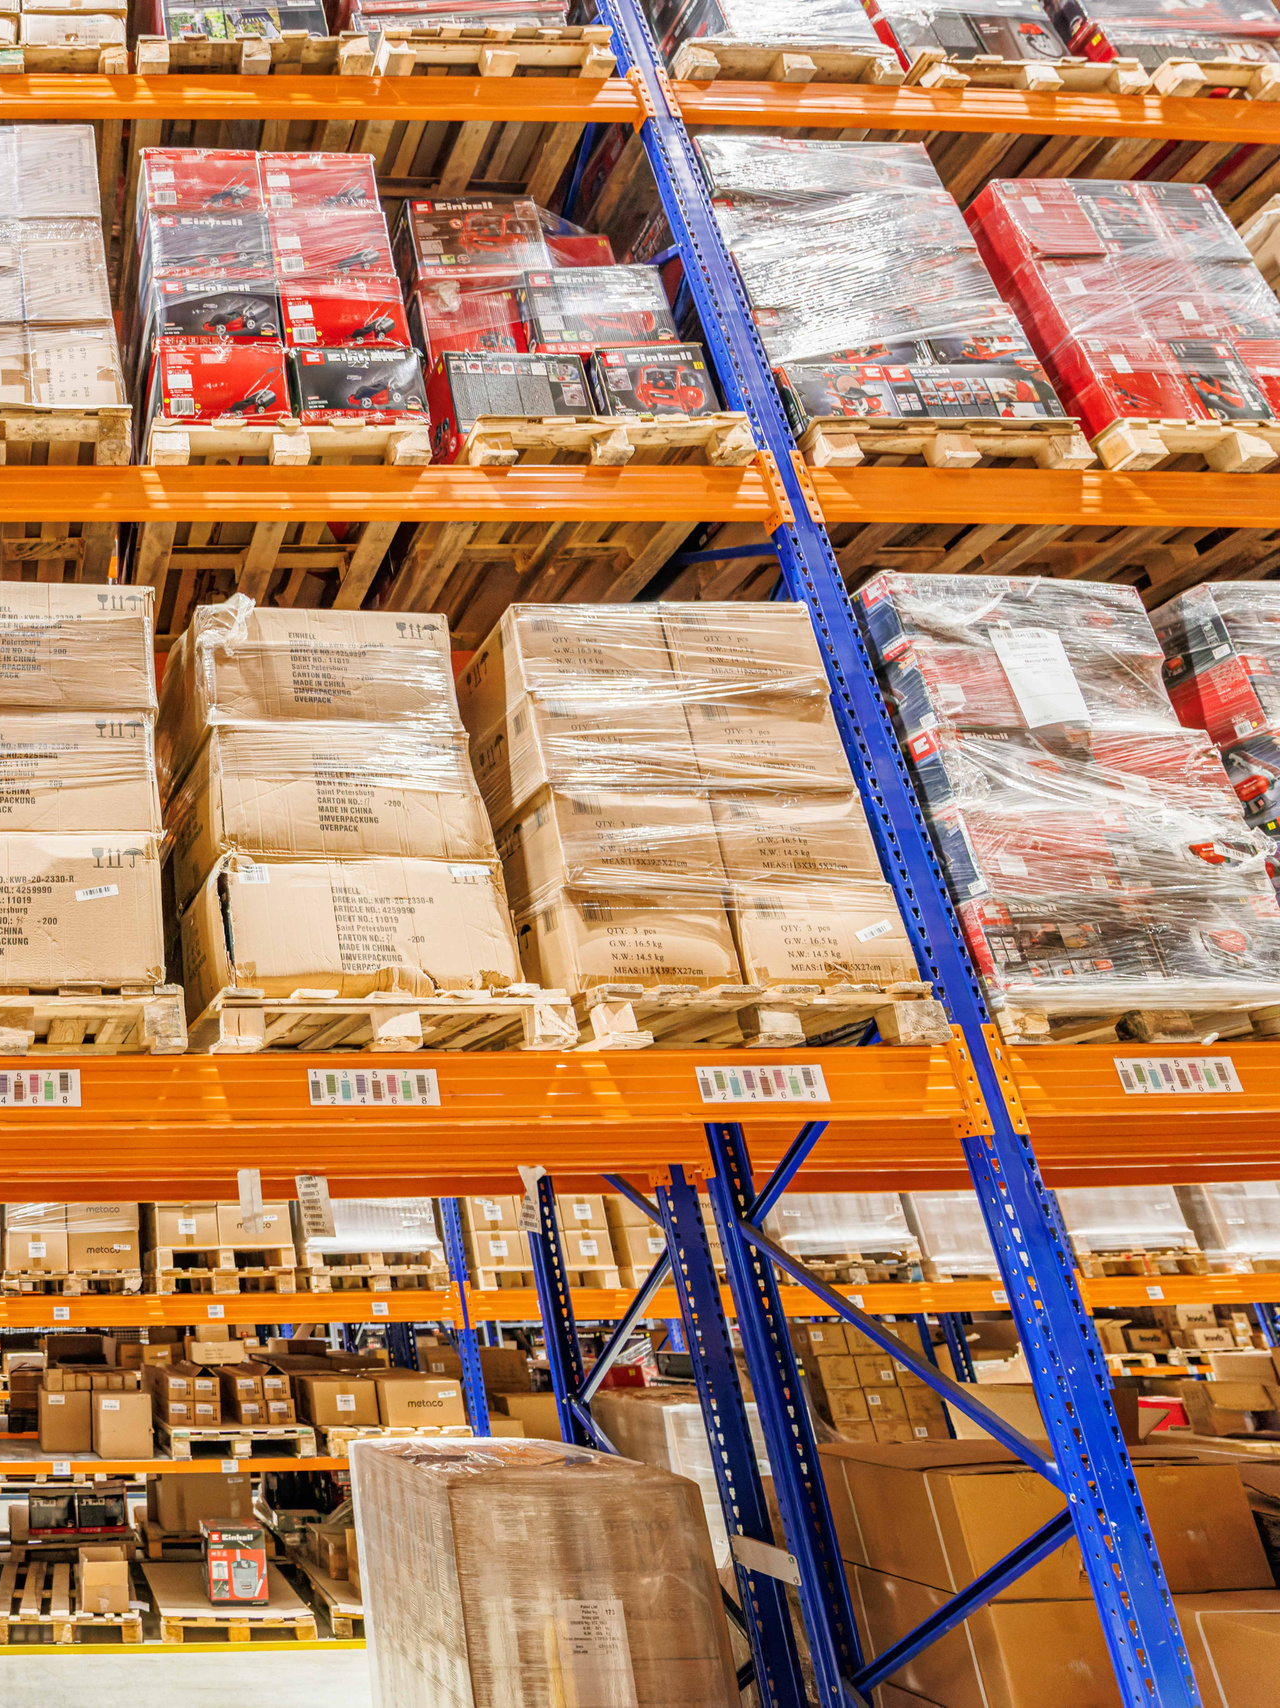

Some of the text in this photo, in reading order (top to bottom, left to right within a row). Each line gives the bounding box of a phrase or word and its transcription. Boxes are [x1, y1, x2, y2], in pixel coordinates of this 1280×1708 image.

[435, 201, 493, 211] Einhell
[181, 217, 243, 226] Einhell
[186, 282, 250, 292] Einhell
[327, 351, 406, 362] Einhell
[627, 351, 693, 363] Einhell
[914, 367, 951, 375] Einhell
[964, 731, 1008, 740] Einhell
[337, 789, 375, 797] Petersburg
[317, 797, 346, 805] CARTON
[319, 815, 379, 823] UMVERPACKUNG
[320, 824, 358, 832] OVERPACK
[798, 837, 807, 845] kg
[0, 886, 14, 894] NO.:
[16, 886, 52, 894] 4259990
[357, 925, 397, 933] Petersburg
[607, 927, 628, 935] QTY:
[818, 925, 830, 933] pcs
[369, 934, 384, 942] NO.:
[653, 941, 662, 949] kg
[340, 953, 403, 962] UMVERPACKUNG
[655, 954, 664, 962] kg
[831, 951, 841, 959] kg
[16, 1073, 22, 1081] 5
[1142, 1085, 1148, 1093] 2
[1198, 1084, 1203, 1092] 6
[32, 1096, 38, 1104] 6
[62, 1096, 68, 1104] 8
[86, 1205, 120, 1213] metaco
[86, 1246, 121, 1254] metaco
[1139, 1334, 1161, 1342] kwb
[1205, 1334, 1224, 1342] kwb
[408, 1399, 443, 1408] metaco
